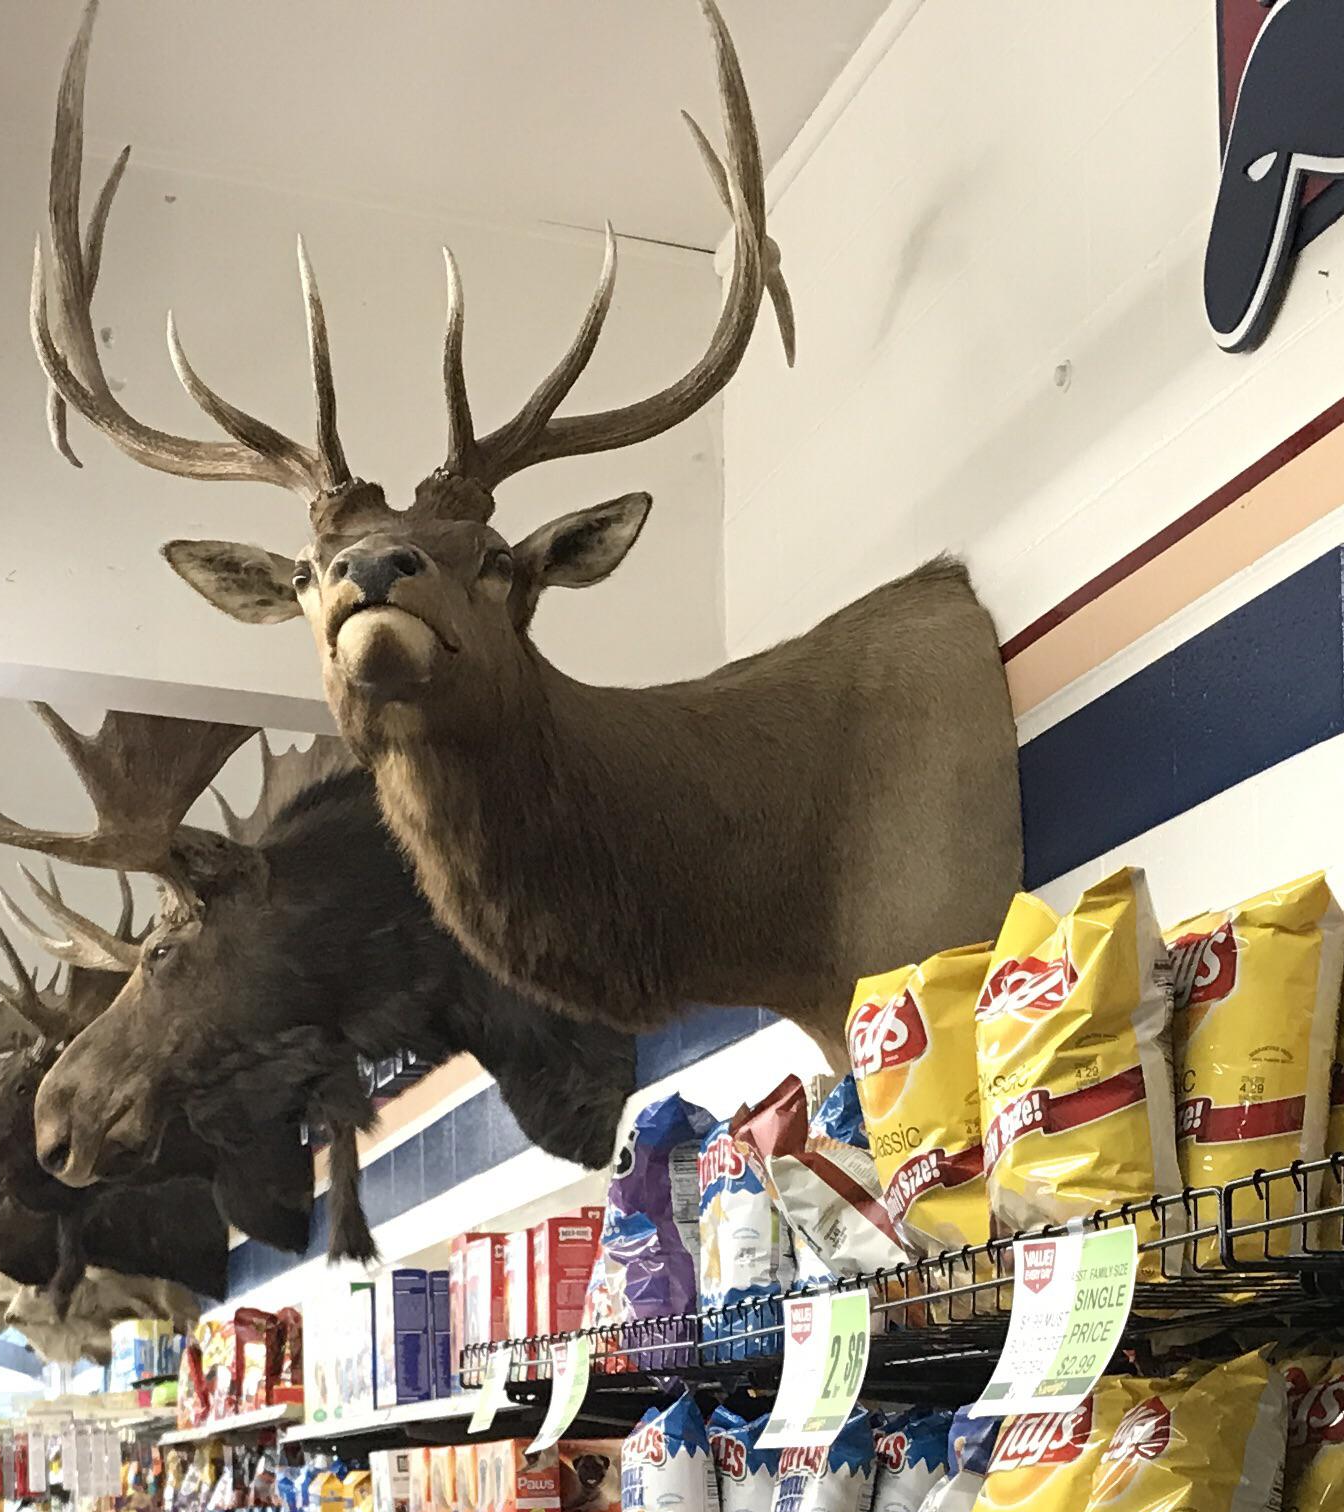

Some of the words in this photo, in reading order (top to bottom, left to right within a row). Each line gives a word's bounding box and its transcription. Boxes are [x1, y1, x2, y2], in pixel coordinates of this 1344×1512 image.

[1074, 1284, 1126, 1312] SINGLE
[1067, 1320, 1113, 1346] PRICE
[1057, 1353, 1096, 1376] $2.99
